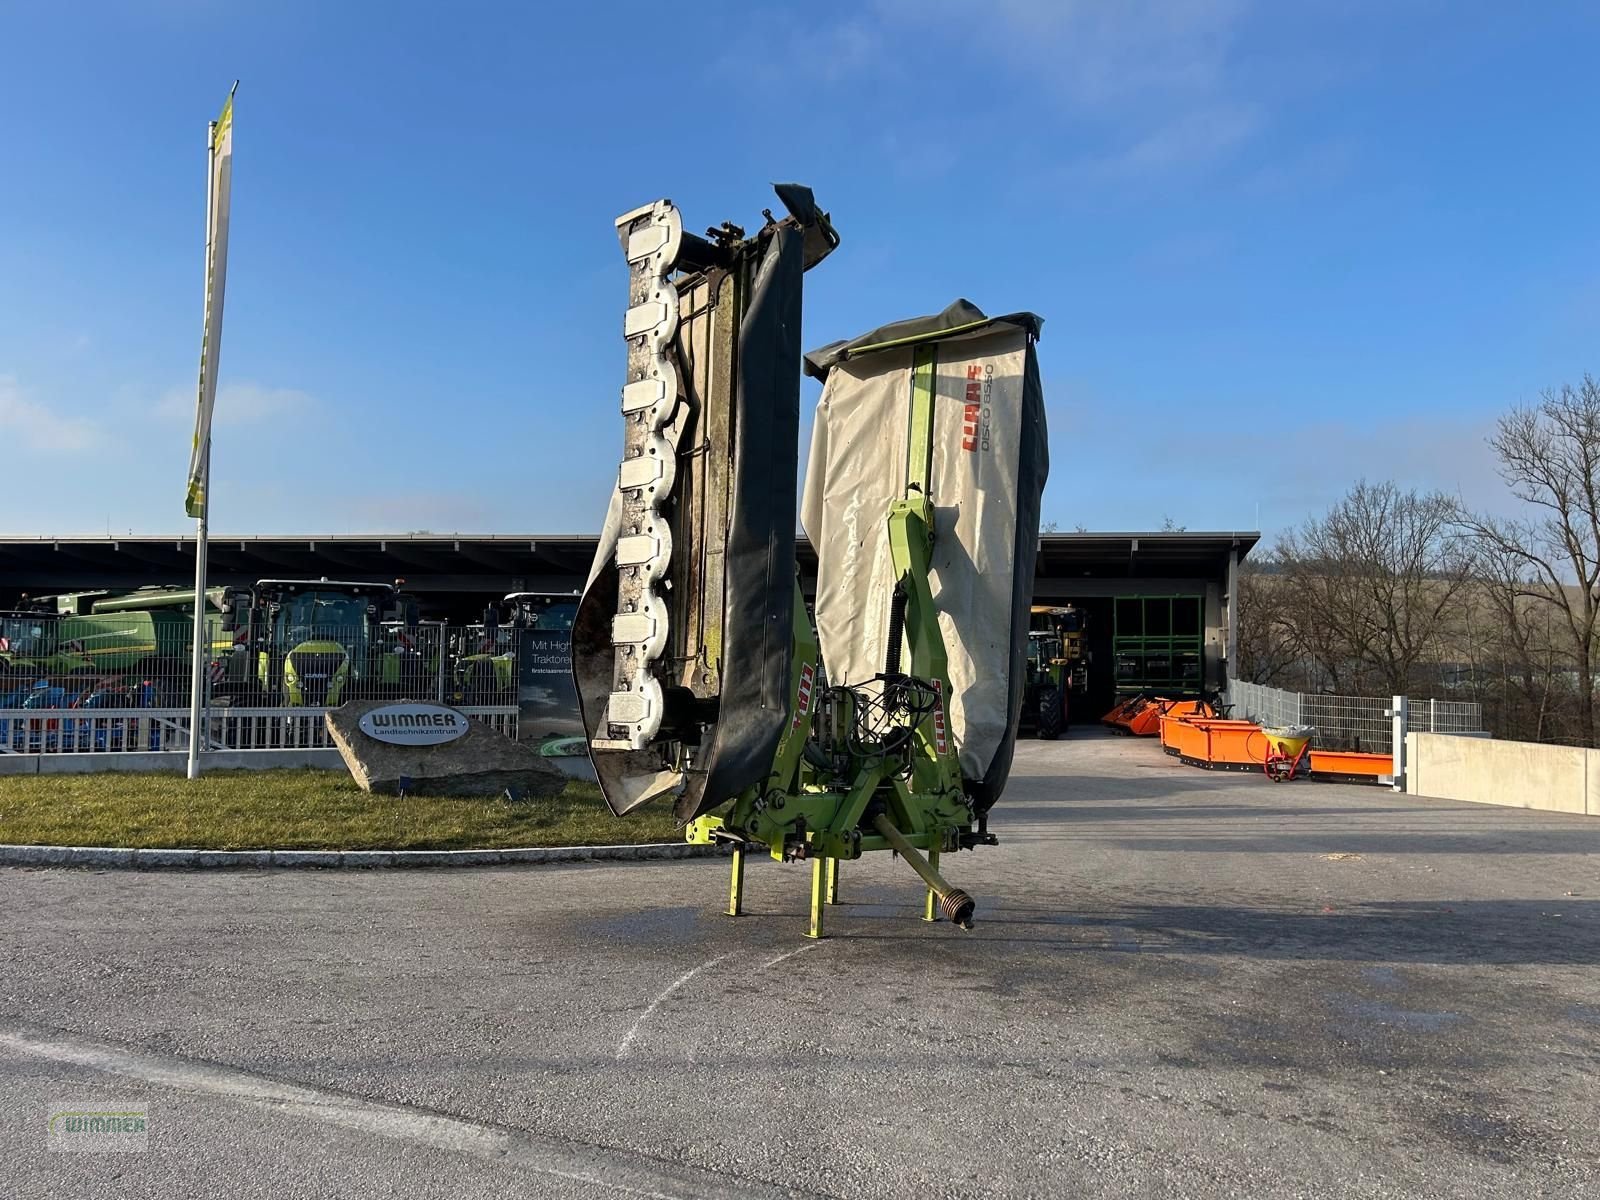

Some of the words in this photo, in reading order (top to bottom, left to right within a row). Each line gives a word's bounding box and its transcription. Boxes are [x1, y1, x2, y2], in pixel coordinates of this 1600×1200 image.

[963, 365, 981, 452] CLAAS
[982, 408, 990, 451] DISCO
[532, 640, 547, 650] Mit
[371, 713, 457, 728] WIMMER
[374, 728, 458, 736] Landtechnikzentrum
